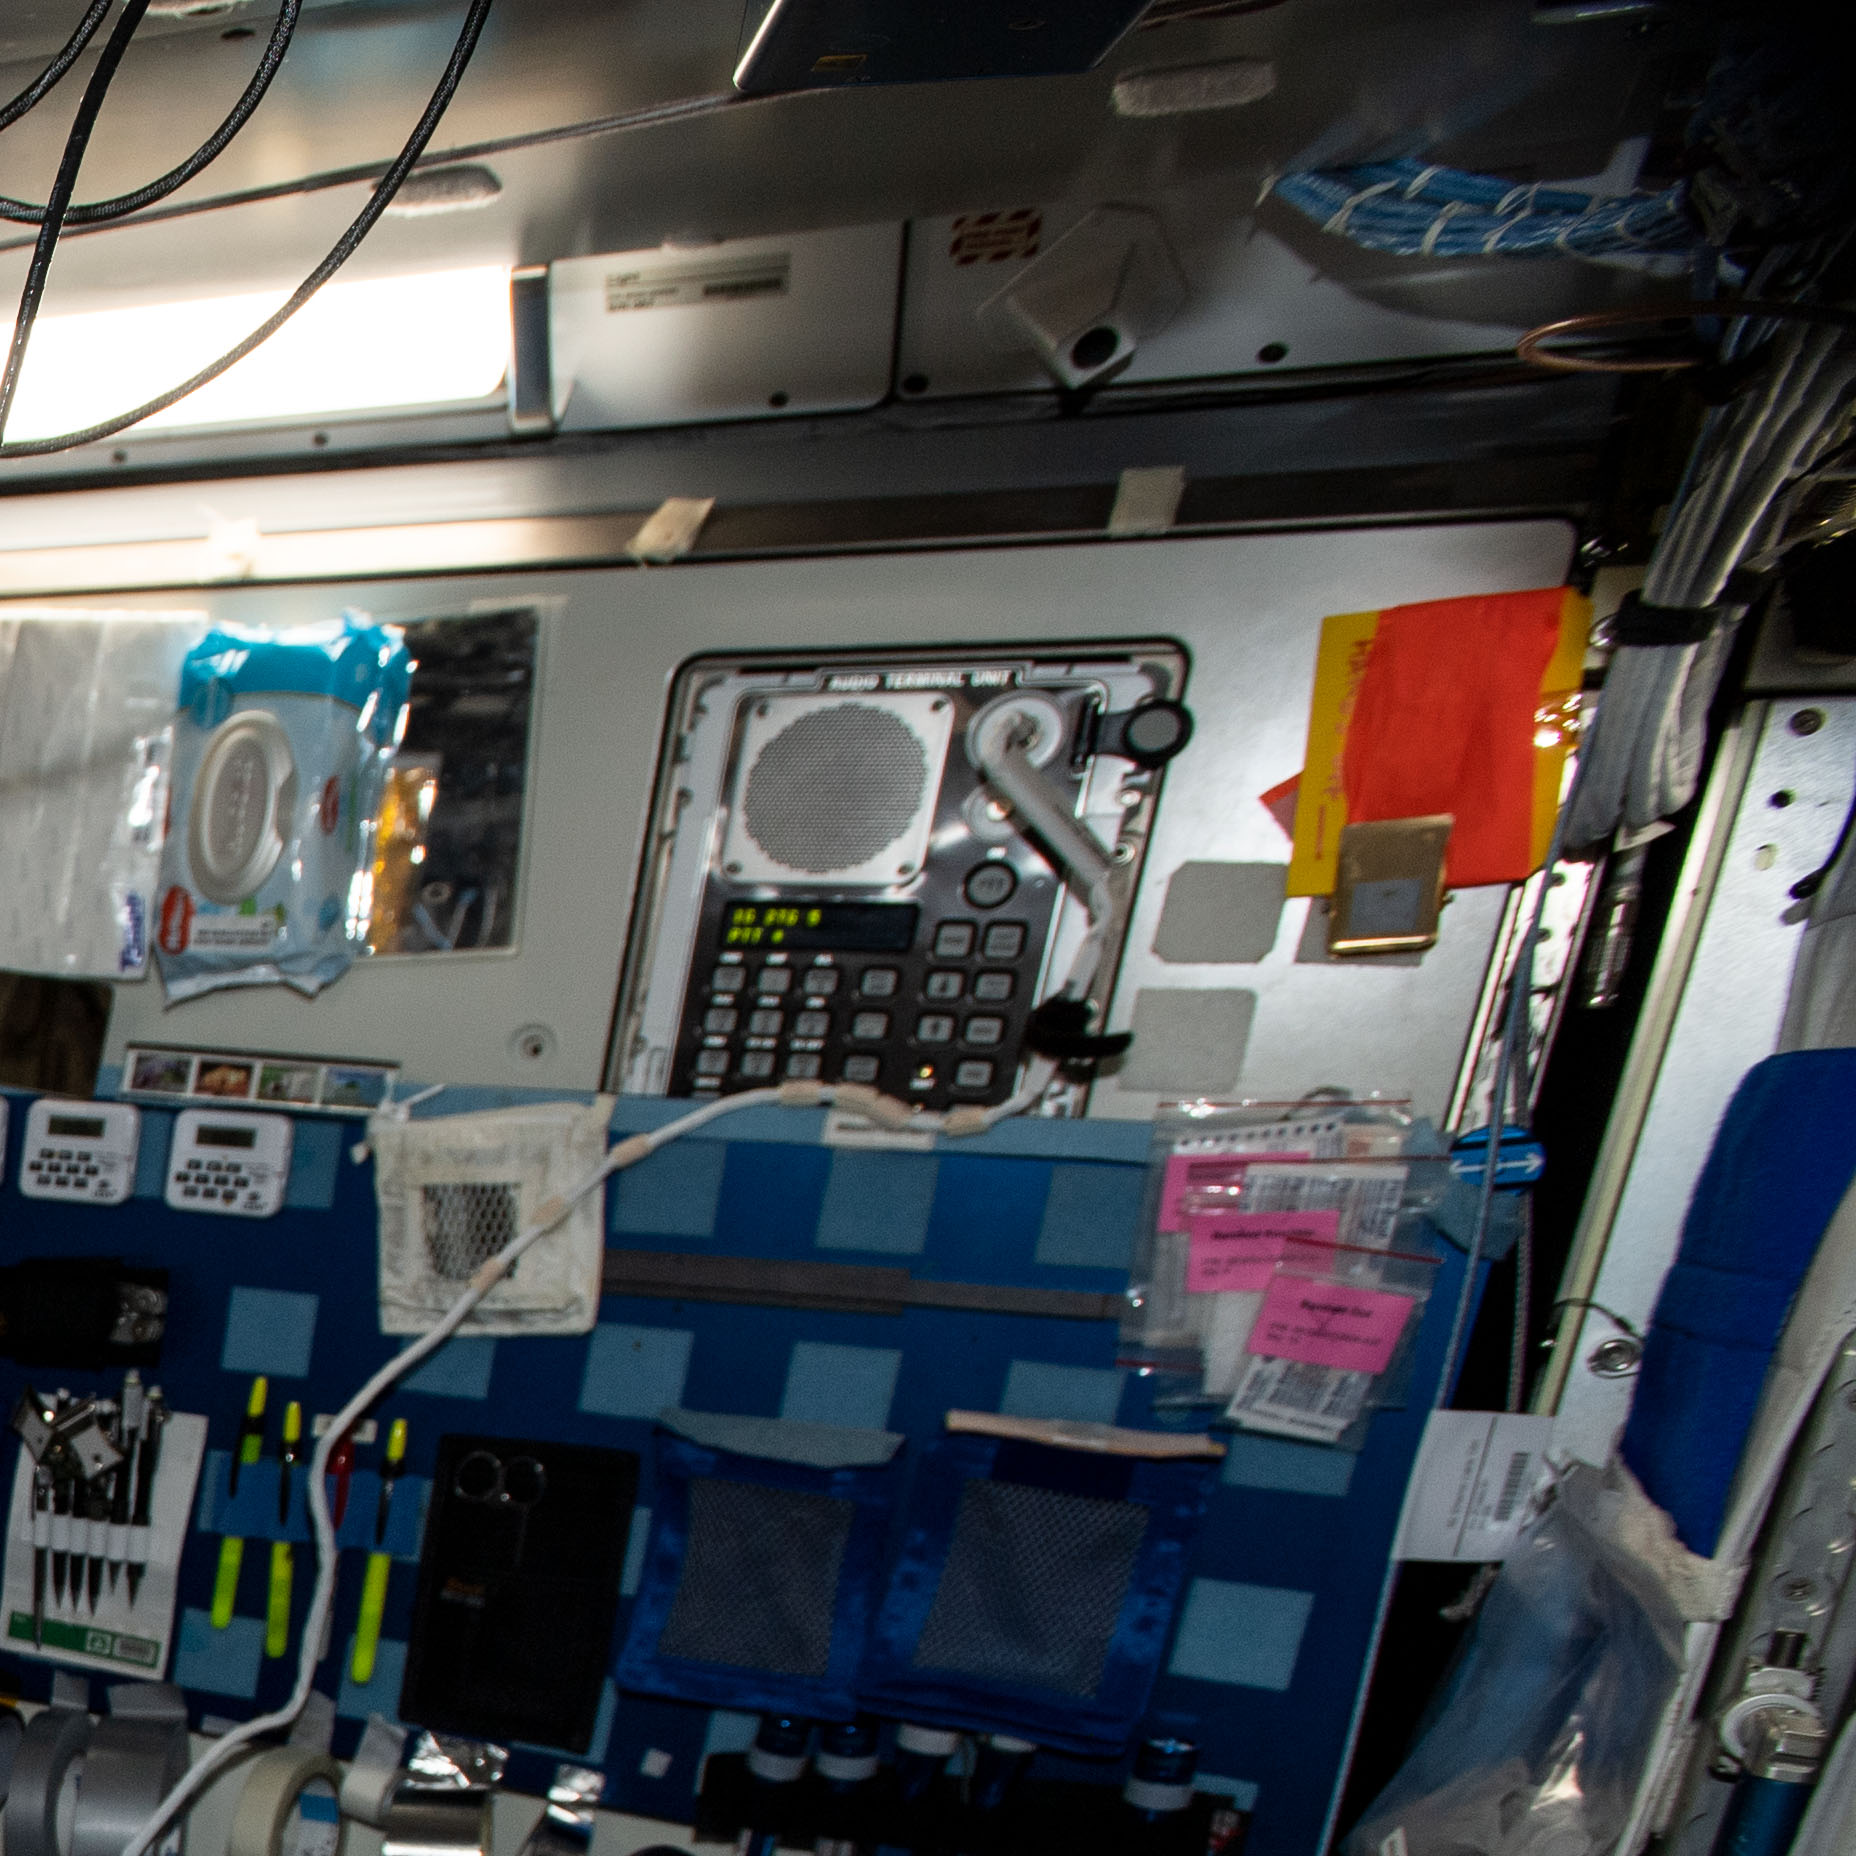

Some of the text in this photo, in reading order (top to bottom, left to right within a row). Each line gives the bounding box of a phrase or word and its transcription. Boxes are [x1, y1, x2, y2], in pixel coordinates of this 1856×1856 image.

[829, 667, 1013, 692] AUDIO TERMINAL UNIT
